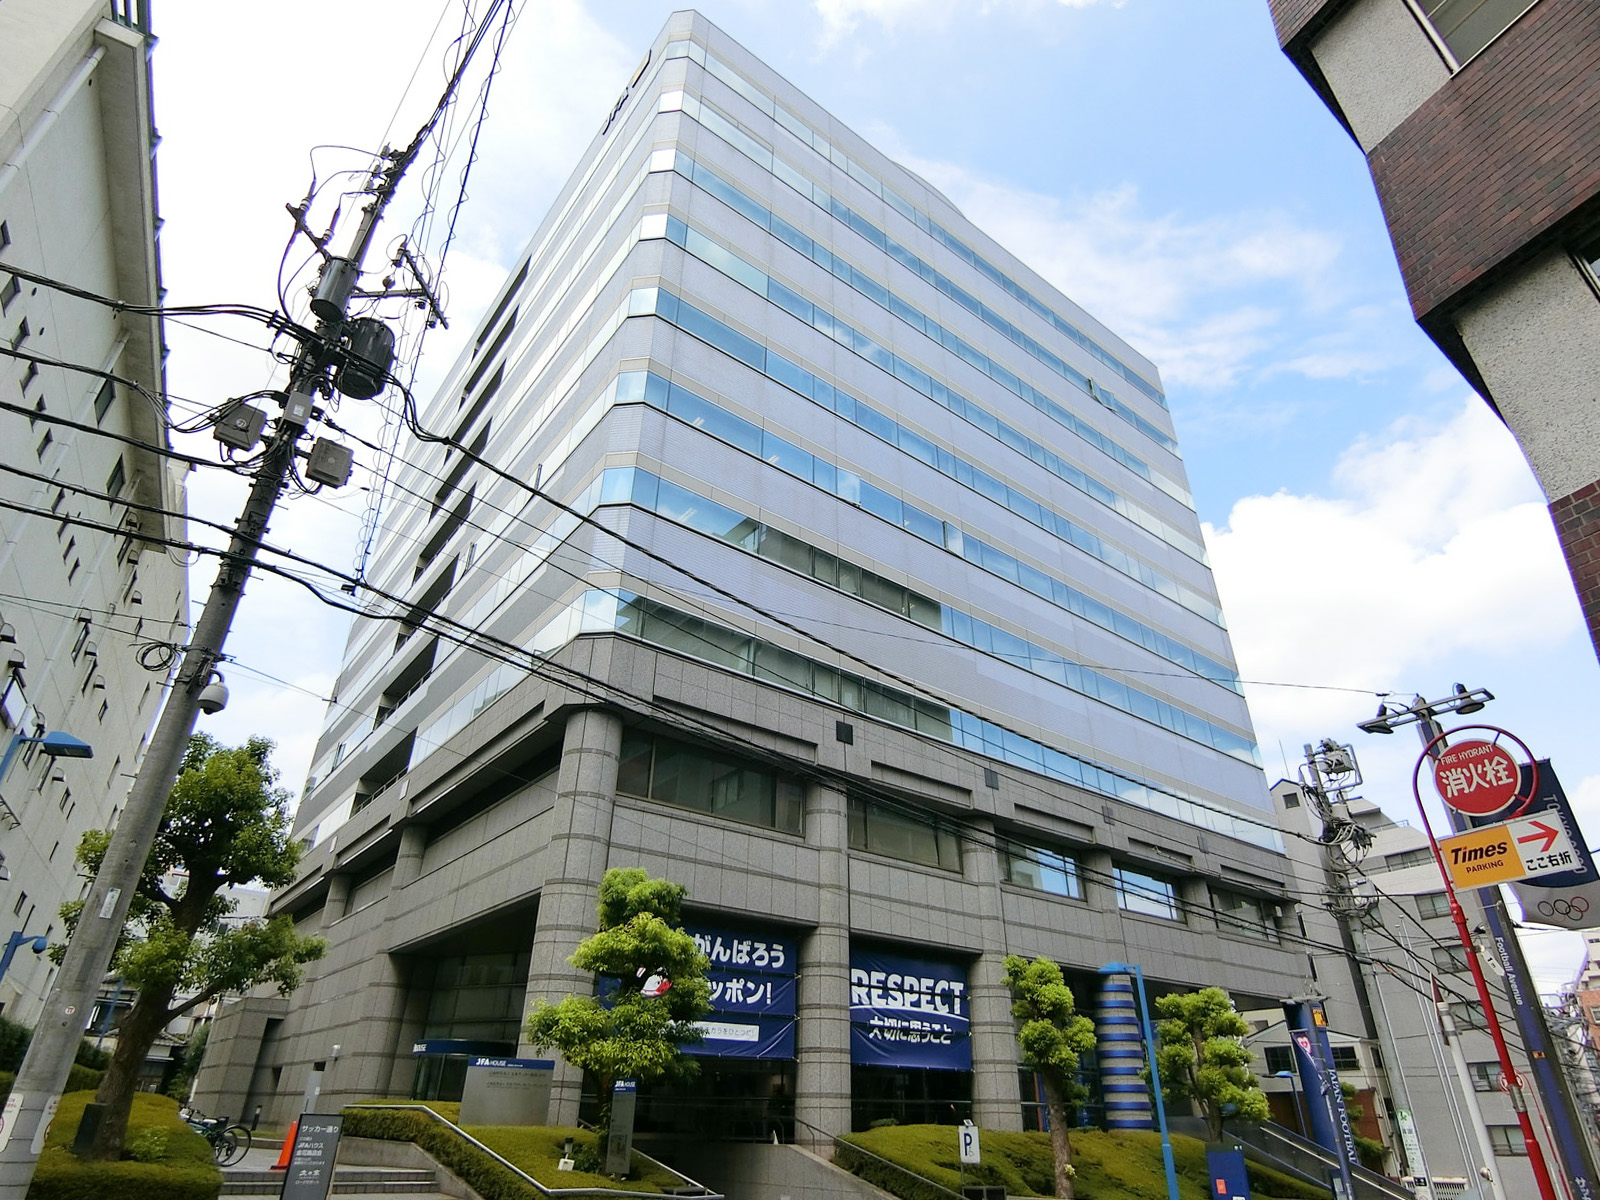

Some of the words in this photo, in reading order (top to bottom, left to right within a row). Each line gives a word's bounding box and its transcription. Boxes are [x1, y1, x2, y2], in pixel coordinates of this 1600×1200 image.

[1441, 754, 1458, 765] FIRE
[1458, 744, 1493, 760] HYDRANT
[1439, 755, 1514, 798] 消火栓
[1450, 842, 1508, 865] Times
[1466, 859, 1504, 874] PARKING
[1526, 851, 1573, 871] ここ右折
[694, 933, 785, 968] がんばろう
[1495, 937, 1513, 974] Football
[1507, 972, 1523, 1006] Avenue
[709, 978, 772, 1005] ッポン!
[851, 968, 964, 1014] RESPECT
[868, 1016, 953, 1044] 大切に思うこと
[476, 1058, 490, 1066] JFA
[1328, 1069, 1343, 1103] JAPAN
[1338, 1107, 1357, 1162] FOOTBAL
[963, 1132, 973, 1156] P
